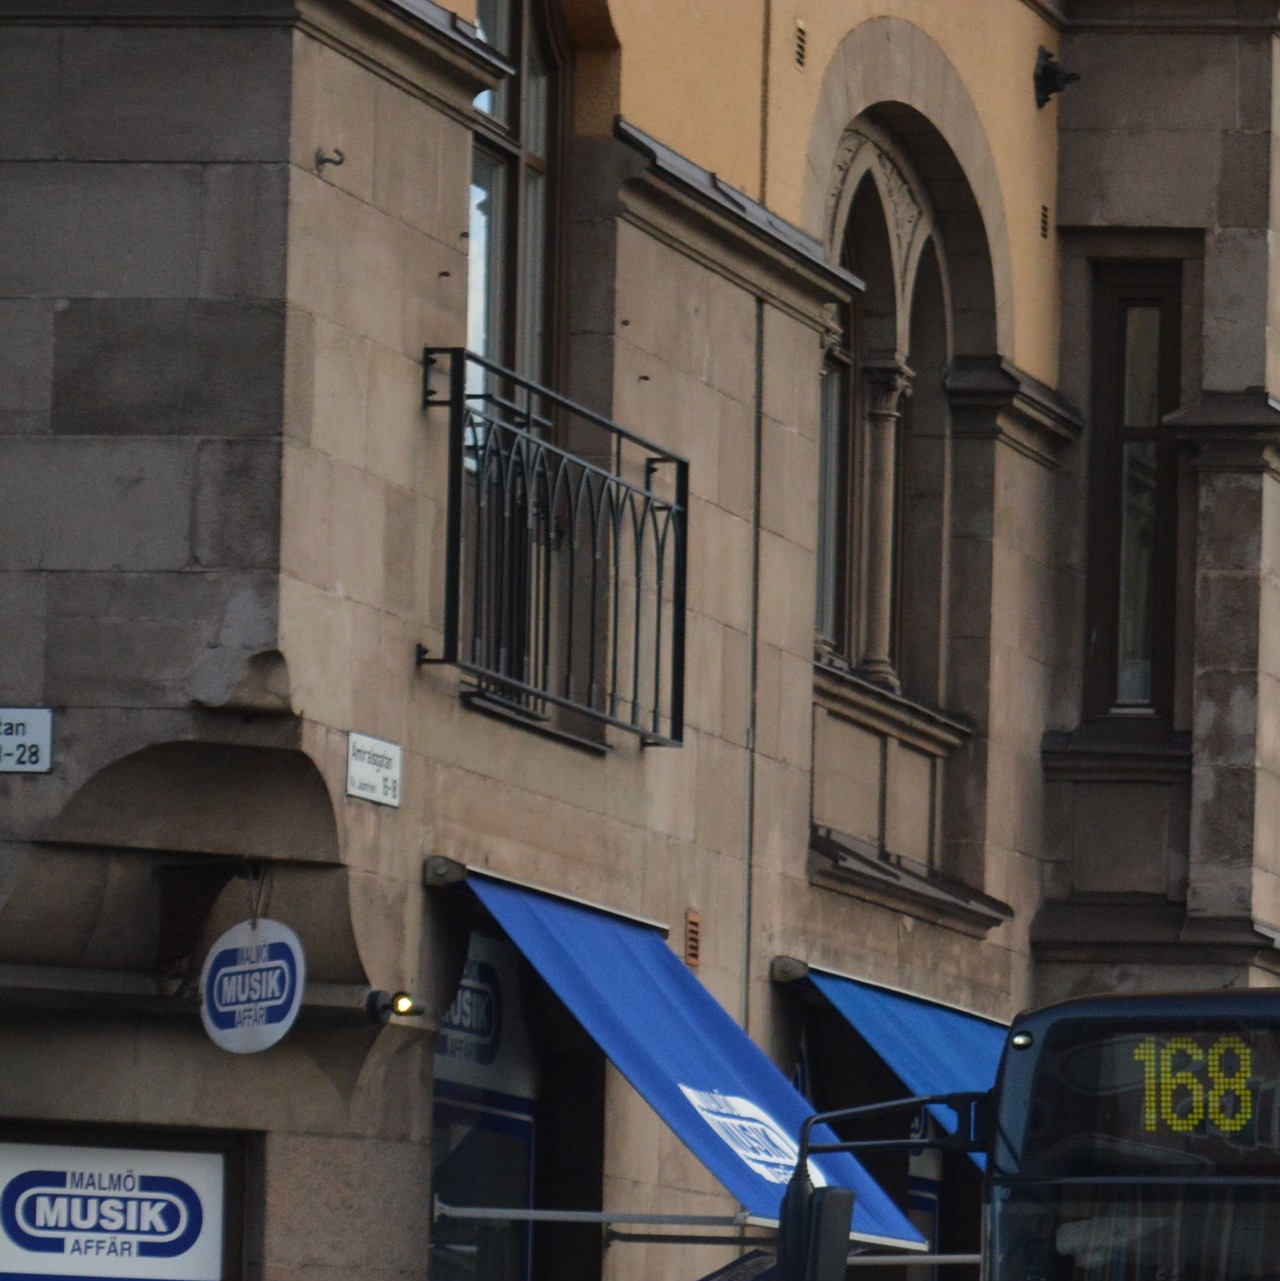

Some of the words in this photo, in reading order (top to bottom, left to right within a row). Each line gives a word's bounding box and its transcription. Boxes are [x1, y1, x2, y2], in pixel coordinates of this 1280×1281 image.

[221, 967, 282, 1005] MUSIK
[1134, 1036, 1252, 1131] 168
[70, 1169, 137, 1193] MALMÖ
[35, 1196, 169, 1233] MUSIK
[70, 1236, 133, 1258] AFFÄR
